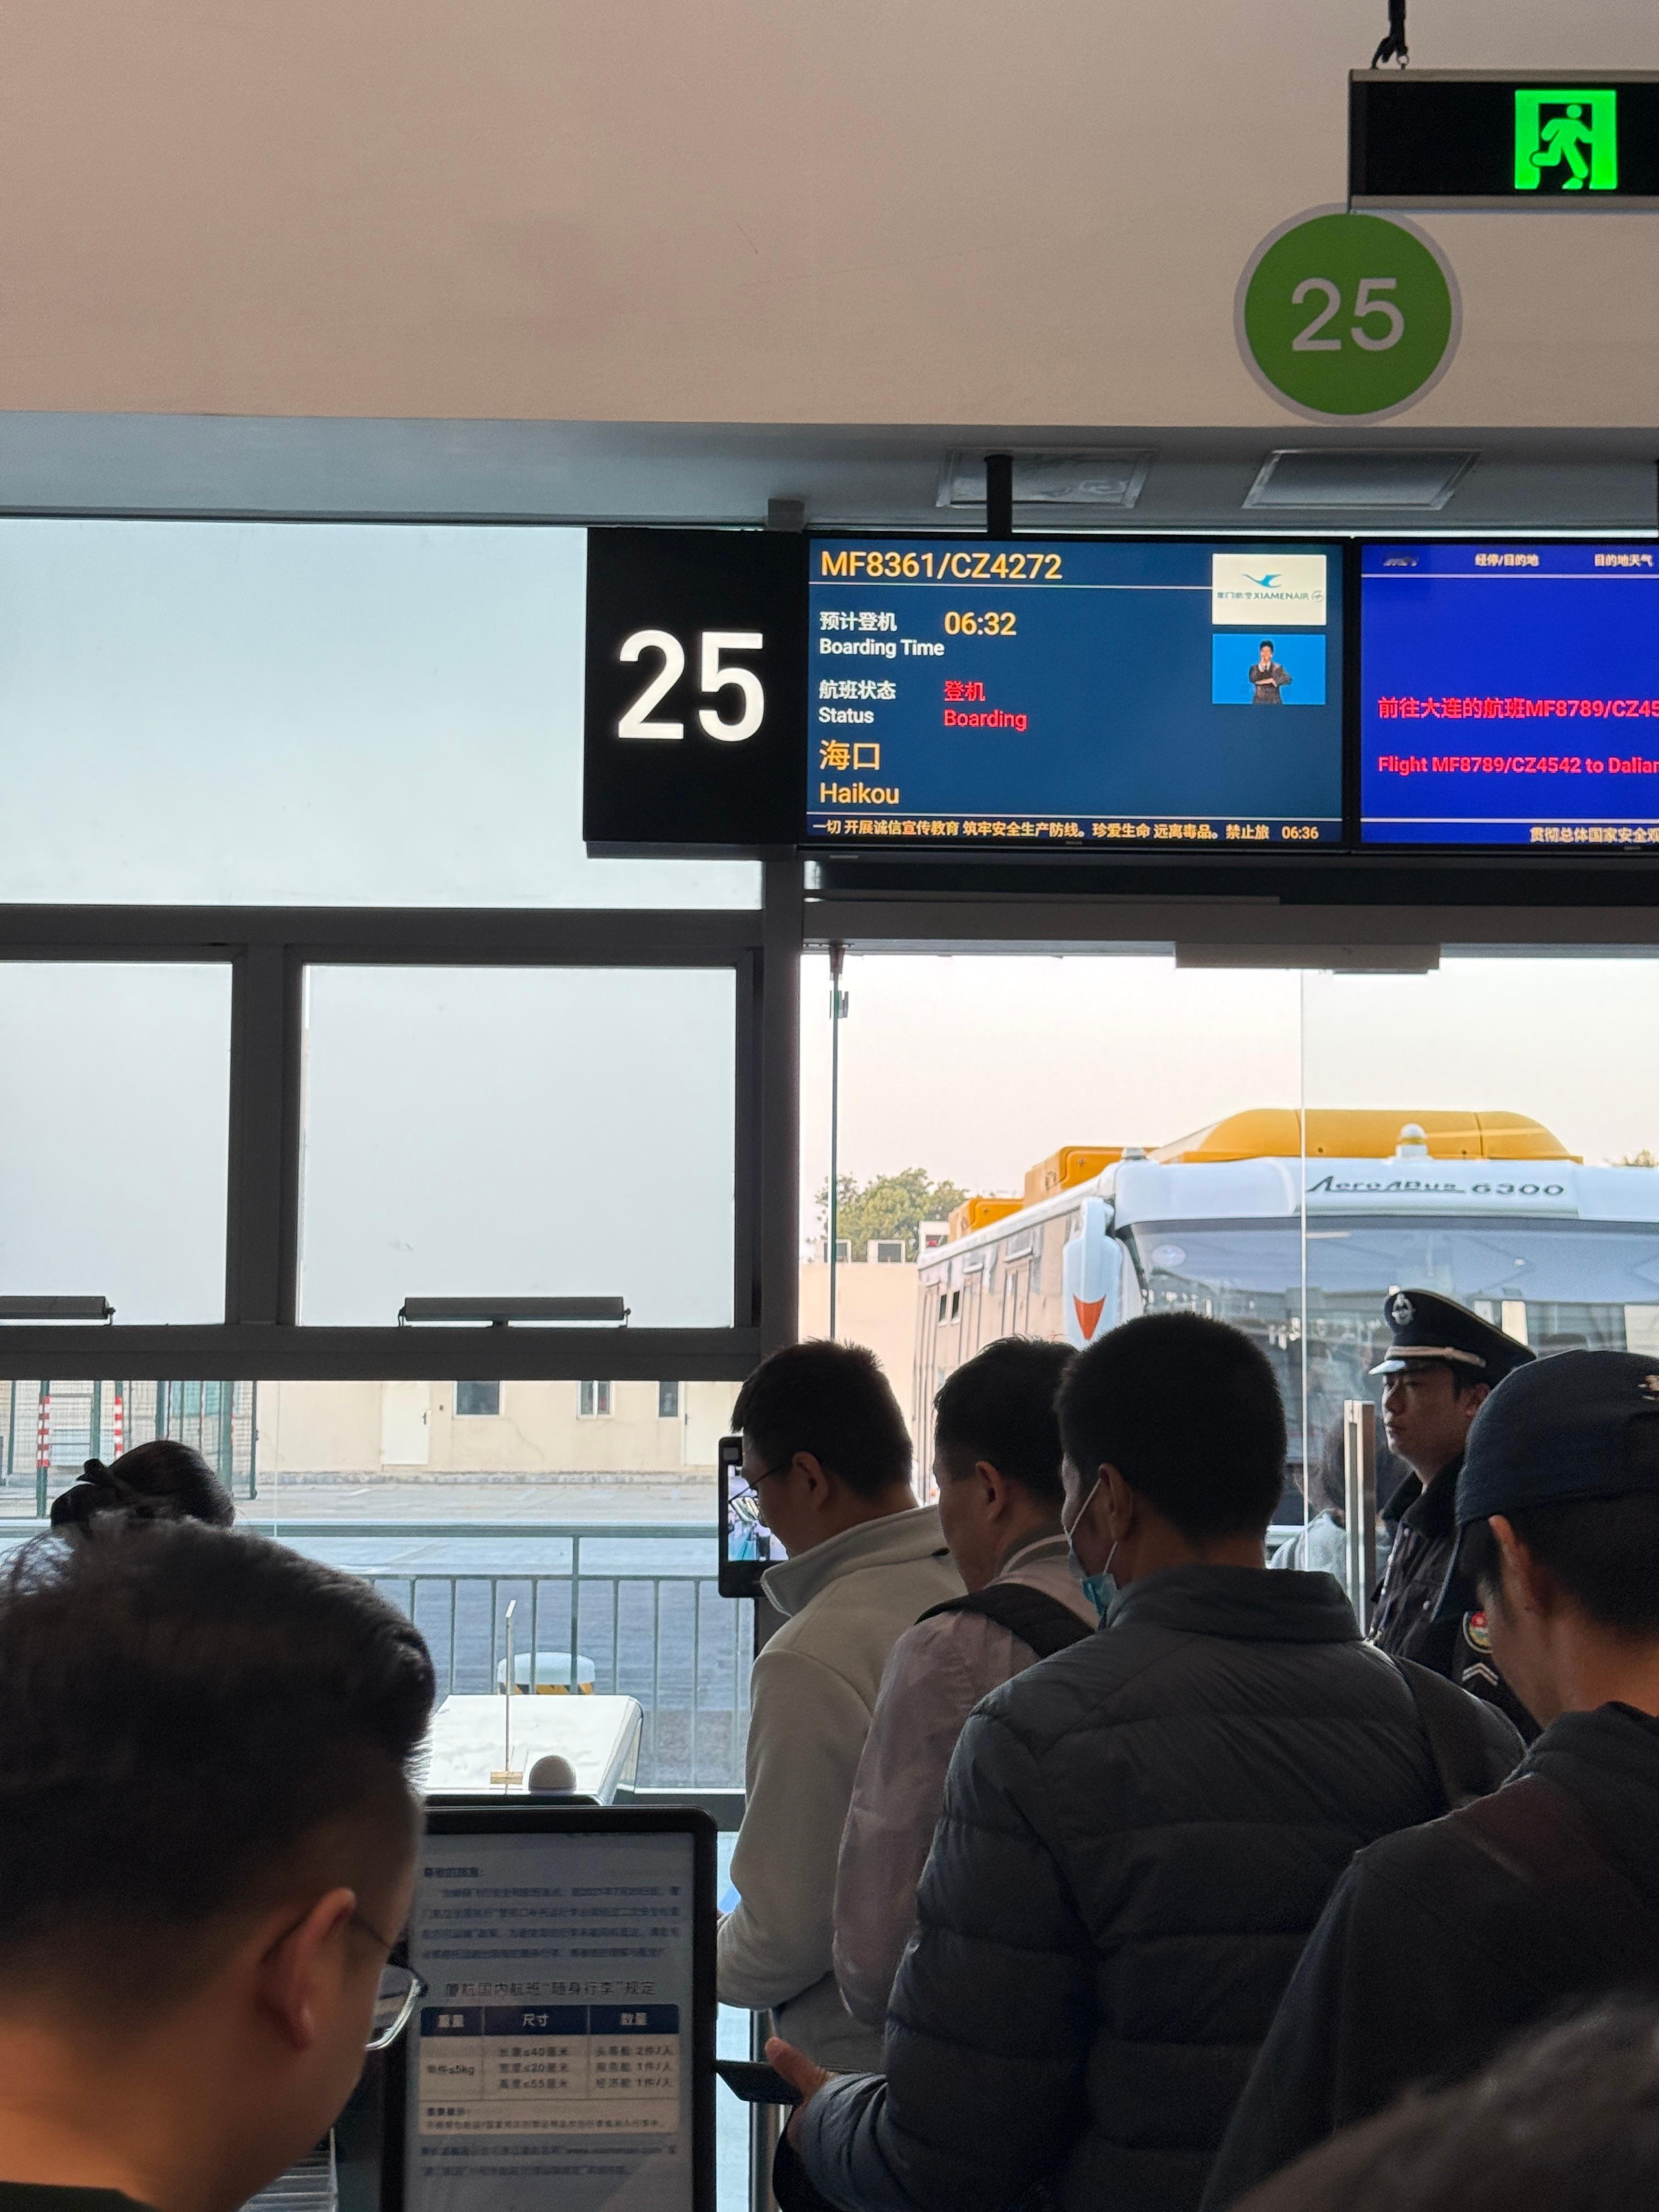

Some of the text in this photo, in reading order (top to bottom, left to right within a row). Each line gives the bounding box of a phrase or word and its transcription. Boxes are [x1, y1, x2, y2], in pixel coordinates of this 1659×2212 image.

[1291, 278, 1404, 352] 25
[821, 550, 1063, 579] MF8361/CZ4272
[1594, 554, 1654, 567] 目的地天气
[819, 612, 898, 632] 预计登机
[944, 611, 1017, 636] 06:32
[819, 638, 945, 658] Boarding Time
[618, 629, 765, 742] 25
[819, 679, 897, 700] 航班状态
[944, 680, 986, 702] 登机
[818, 706, 874, 724] Status
[944, 708, 1028, 731] Boarding
[819, 739, 881, 771] 海口
[1378, 756, 1427, 776] Flight
[1432, 757, 1581, 774] MF8789/CZ4542
[1585, 758, 1604, 774] to
[820, 782, 900, 805] Haikou
[812, 820, 1269, 840] 一切 开展诚信宣传教育 筑牢安全生产防线。 珍爱生命 远离毒品。 禁止旅
[1282, 826, 1319, 840] 06:36
[1472, 1183, 1565, 1197] 6300
[522, 2013, 549, 2027] 尺寸
